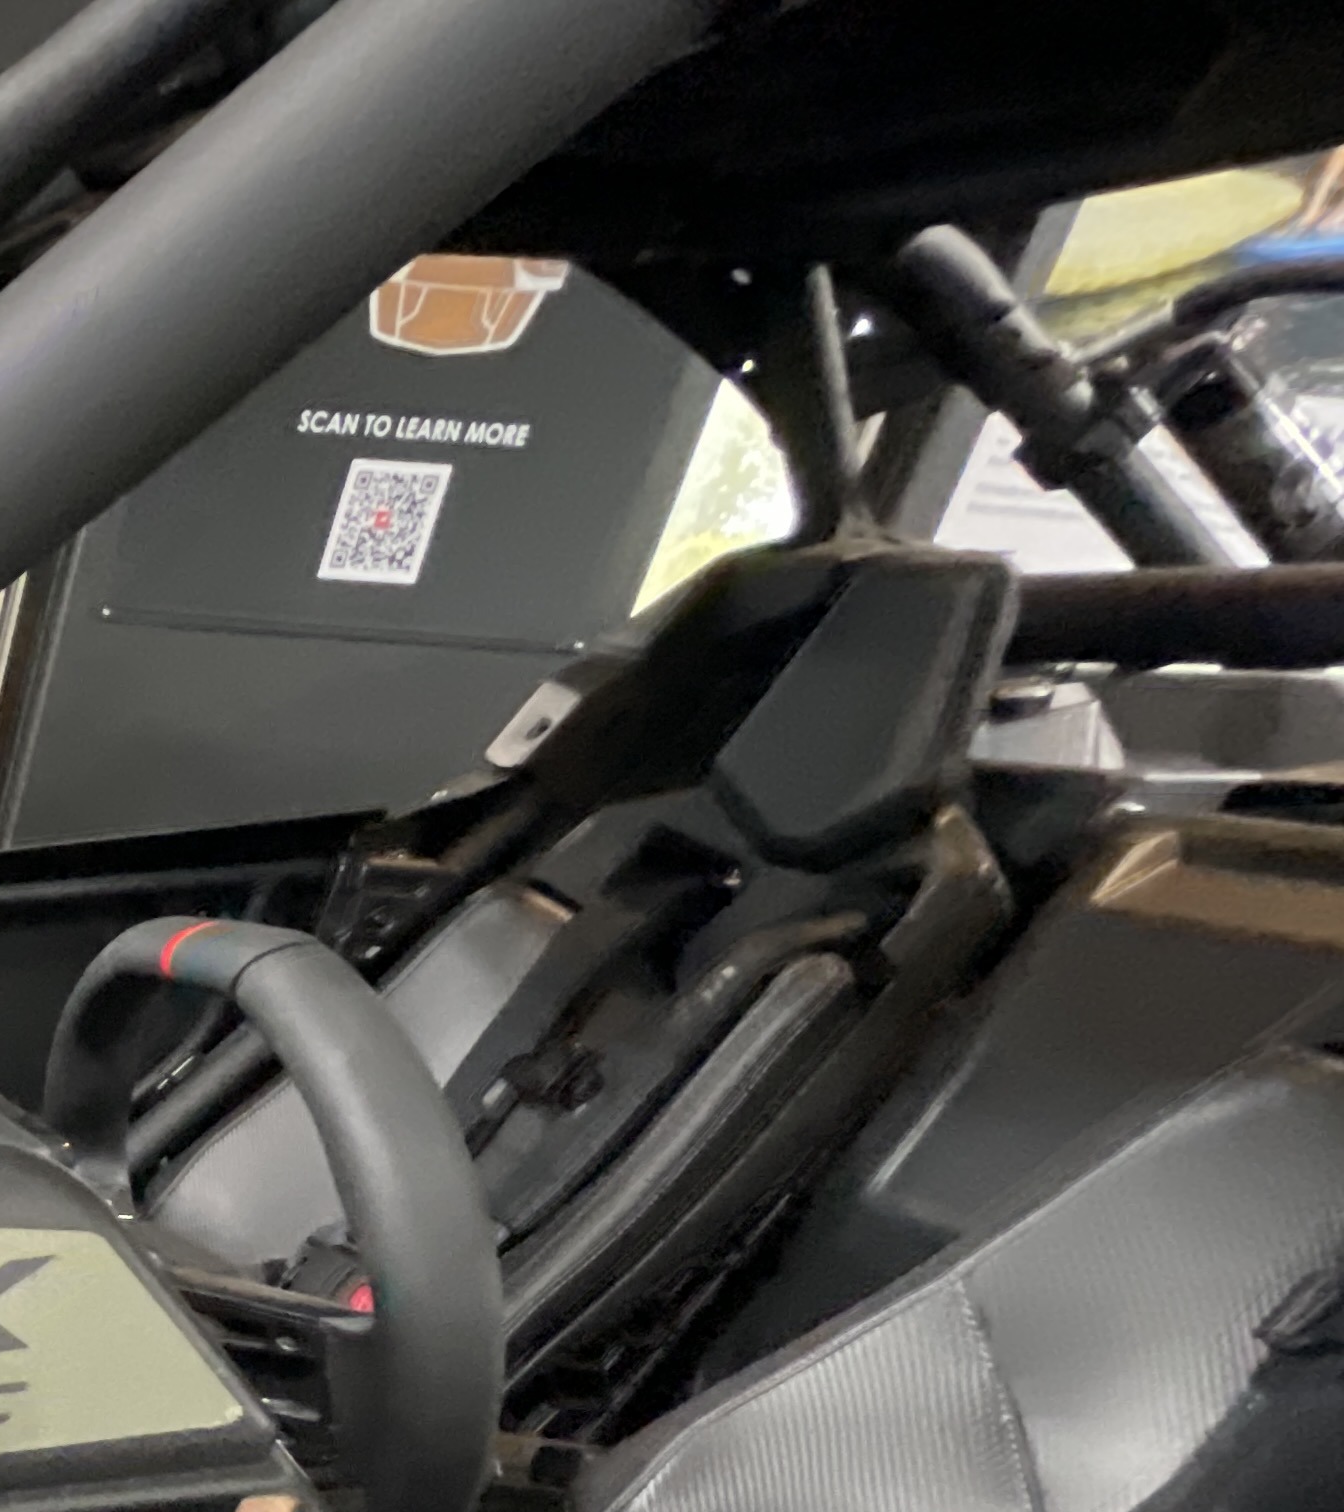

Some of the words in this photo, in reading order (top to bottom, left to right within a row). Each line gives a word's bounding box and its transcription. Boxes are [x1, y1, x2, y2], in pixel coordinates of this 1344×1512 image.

[297, 409, 360, 435] SCAN
[363, 414, 393, 438] TO
[395, 416, 463, 442] LEARN
[464, 421, 531, 447] MORE
